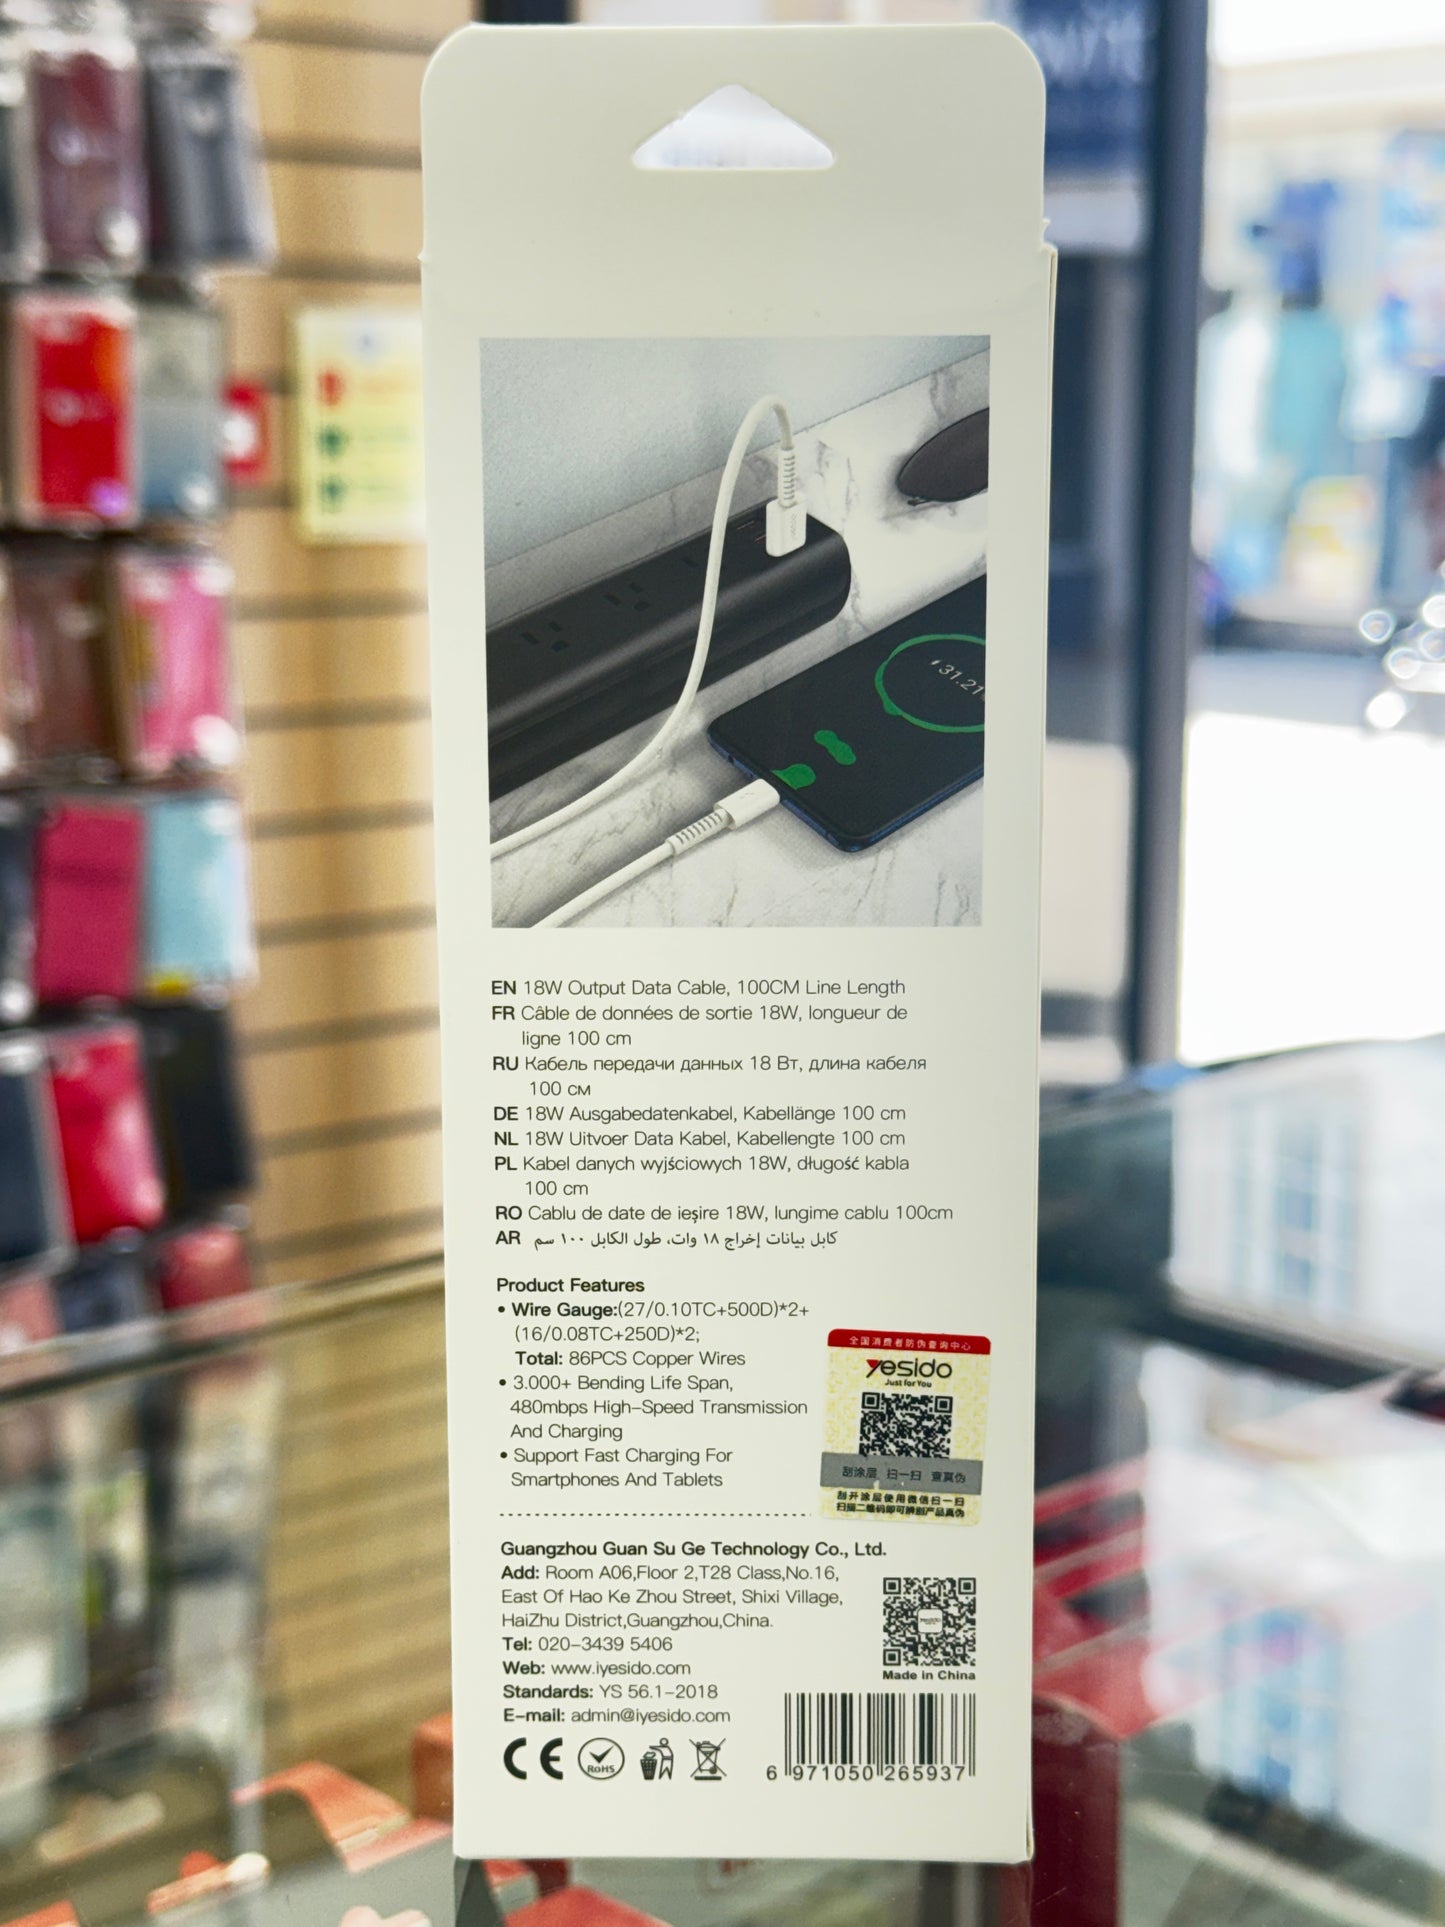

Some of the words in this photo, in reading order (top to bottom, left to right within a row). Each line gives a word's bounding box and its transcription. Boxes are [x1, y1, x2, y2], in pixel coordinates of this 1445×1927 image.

[938, 664, 985, 702] 31.21
[491, 979, 517, 996] EN
[523, 979, 563, 996] 18W
[566, 979, 627, 999] Output
[631, 979, 672, 996] Data
[676, 979, 731, 998] Cable,
[737, 978, 800, 996] 100CM
[805, 979, 842, 995] Line
[847, 978, 906, 999] Length
[491, 1005, 516, 1021] FR
[520, 1004, 571, 1021] Câble
[575, 1004, 597, 1021] de
[601, 1004, 674, 1021] données
[678, 1004, 701, 1021] de
[705, 1005, 753, 1021] sortie
[759, 1004, 803, 1023] 18W,
[808, 1004, 882, 1024] longueur
[886, 1004, 908, 1021] de
[521, 1030, 562, 1050] ligne
[567, 1029, 601, 1047] 100
[605, 1033, 632, 1047] cm
[492, 1055, 520, 1072] RU
[525, 1055, 589, 1072] Кабель
[593, 1058, 675, 1075] передачи
[679, 1058, 744, 1074] данных
[749, 1054, 772, 1071] 18
[777, 1054, 804, 1073] Вт,
[808, 1058, 861, 1073] длина
[866, 1055, 927, 1071] кабеля
[529, 1080, 562, 1097] 100
[567, 1083, 592, 1097] см
[493, 1105, 520, 1122] DE
[525, 1105, 565, 1122] 18W
[568, 1105, 738, 1125] Ausgabedatenkabel,
[743, 1105, 836, 1125] Kabellänge
[842, 1104, 875, 1121] 100
[879, 1108, 906, 1121] cm
[493, 1130, 520, 1147] NL
[525, 1130, 565, 1147] 18W
[569, 1130, 630, 1147] Uitvoer
[634, 1130, 674, 1147] Data
[679, 1130, 731, 1149] Kabel,
[736, 1130, 836, 1150] Kabellengte
[841, 1129, 875, 1146] 100
[879, 1133, 906, 1146] cm
[494, 1155, 519, 1172] PL
[523, 1155, 570, 1172] Kabel
[575, 1155, 636, 1175] danych
[639, 1155, 742, 1175] wyjściowych
[748, 1154, 792, 1174] 18W,
[796, 1154, 861, 1175] długość
[865, 1154, 910, 1171] kabla
[524, 1180, 558, 1197] 100
[562, 1183, 589, 1197] cm
[495, 1204, 523, 1221] RO
[527, 1204, 577, 1221] Cablu
[581, 1204, 603, 1221] de
[607, 1204, 646, 1221] date
[650, 1204, 673, 1221] de
[726, 1204, 769, 1223] 18W,
[774, 1204, 840, 1225] lungime
[843, 1204, 889, 1221] cablu
[896, 1204, 954, 1221] 100cm
[494, 1229, 522, 1246] AR
[496, 1277, 565, 1293] Product
[569, 1277, 646, 1293] Features
[510, 1301, 552, 1318] Wire
[849, 1335, 971, 1351] 全国消费者防伪查询中心
[514, 1350, 564, 1367] Total:
[568, 1350, 628, 1367] 86PCS
[632, 1350, 695, 1370] Copper
[698, 1350, 747, 1366] Wires
[512, 1374, 573, 1391] 3.000+
[577, 1374, 645, 1394] Bending
[650, 1374, 683, 1391] Life
[687, 1374, 734, 1394] Span,
[884, 1379, 902, 1387] Just
[903, 1379, 915, 1387] for
[917, 1380, 932, 1388] You
[509, 1398, 589, 1418] 480mbps
[698, 1398, 808, 1415] Transmission
[509, 1423, 543, 1439] And
[547, 1423, 623, 1443] Charging
[513, 1447, 580, 1467] Support
[584, 1447, 621, 1463] Fast
[625, 1447, 701, 1467] Charging
[705, 1447, 734, 1463] For
[510, 1471, 621, 1491] Smartphones
[624, 1471, 658, 1488] And
[661, 1471, 724, 1488] Tablets
[842, 1465, 877, 1479] 刮涂层
[886, 1468, 922, 1481] 扫一扫
[500, 1540, 598, 1560] Guangzhou
[602, 1540, 649, 1557] Guan
[652, 1540, 677, 1557] Su
[680, 1540, 707, 1557] Ge
[709, 1540, 811, 1560] Technology
[814, 1540, 849, 1560] Co.,
[854, 1540, 888, 1557] Ltd.
[500, 1564, 540, 1581] Add:
[545, 1564, 594, 1581] Room
[598, 1564, 679, 1583] A06,Floor
[683, 1564, 732, 1583] 2,T28
[736, 1564, 840, 1583] Class,No.16,
[501, 1588, 539, 1605] East
[542, 1588, 565, 1604] Of
[569, 1588, 604, 1604] Hao
[608, 1588, 631, 1605] Ke
[635, 1588, 678, 1605] Zhou
[682, 1588, 737, 1607] Street,
[741, 1588, 780, 1605] Shixi
[784, 1588, 844, 1608] Village,
[501, 1612, 560, 1628] HaiZhu
[564, 1612, 774, 1632] District,Guangzhou,China.
[501, 1635, 533, 1652] Tel:
[629, 1635, 674, 1652] 5406
[501, 1659, 546, 1676] Web:
[550, 1660, 692, 1679] www.iyesido.com
[882, 1669, 918, 1681] Made
[921, 1669, 934, 1681] in
[937, 1669, 977, 1681] China
[502, 1683, 594, 1700] Standards:
[598, 1683, 623, 1700] YS
[570, 1707, 731, 1726] admin@iyesido.com
[503, 1737, 564, 1780] CE
[587, 1764, 615, 1774] RoHS
[766, 1764, 778, 1781] 6
